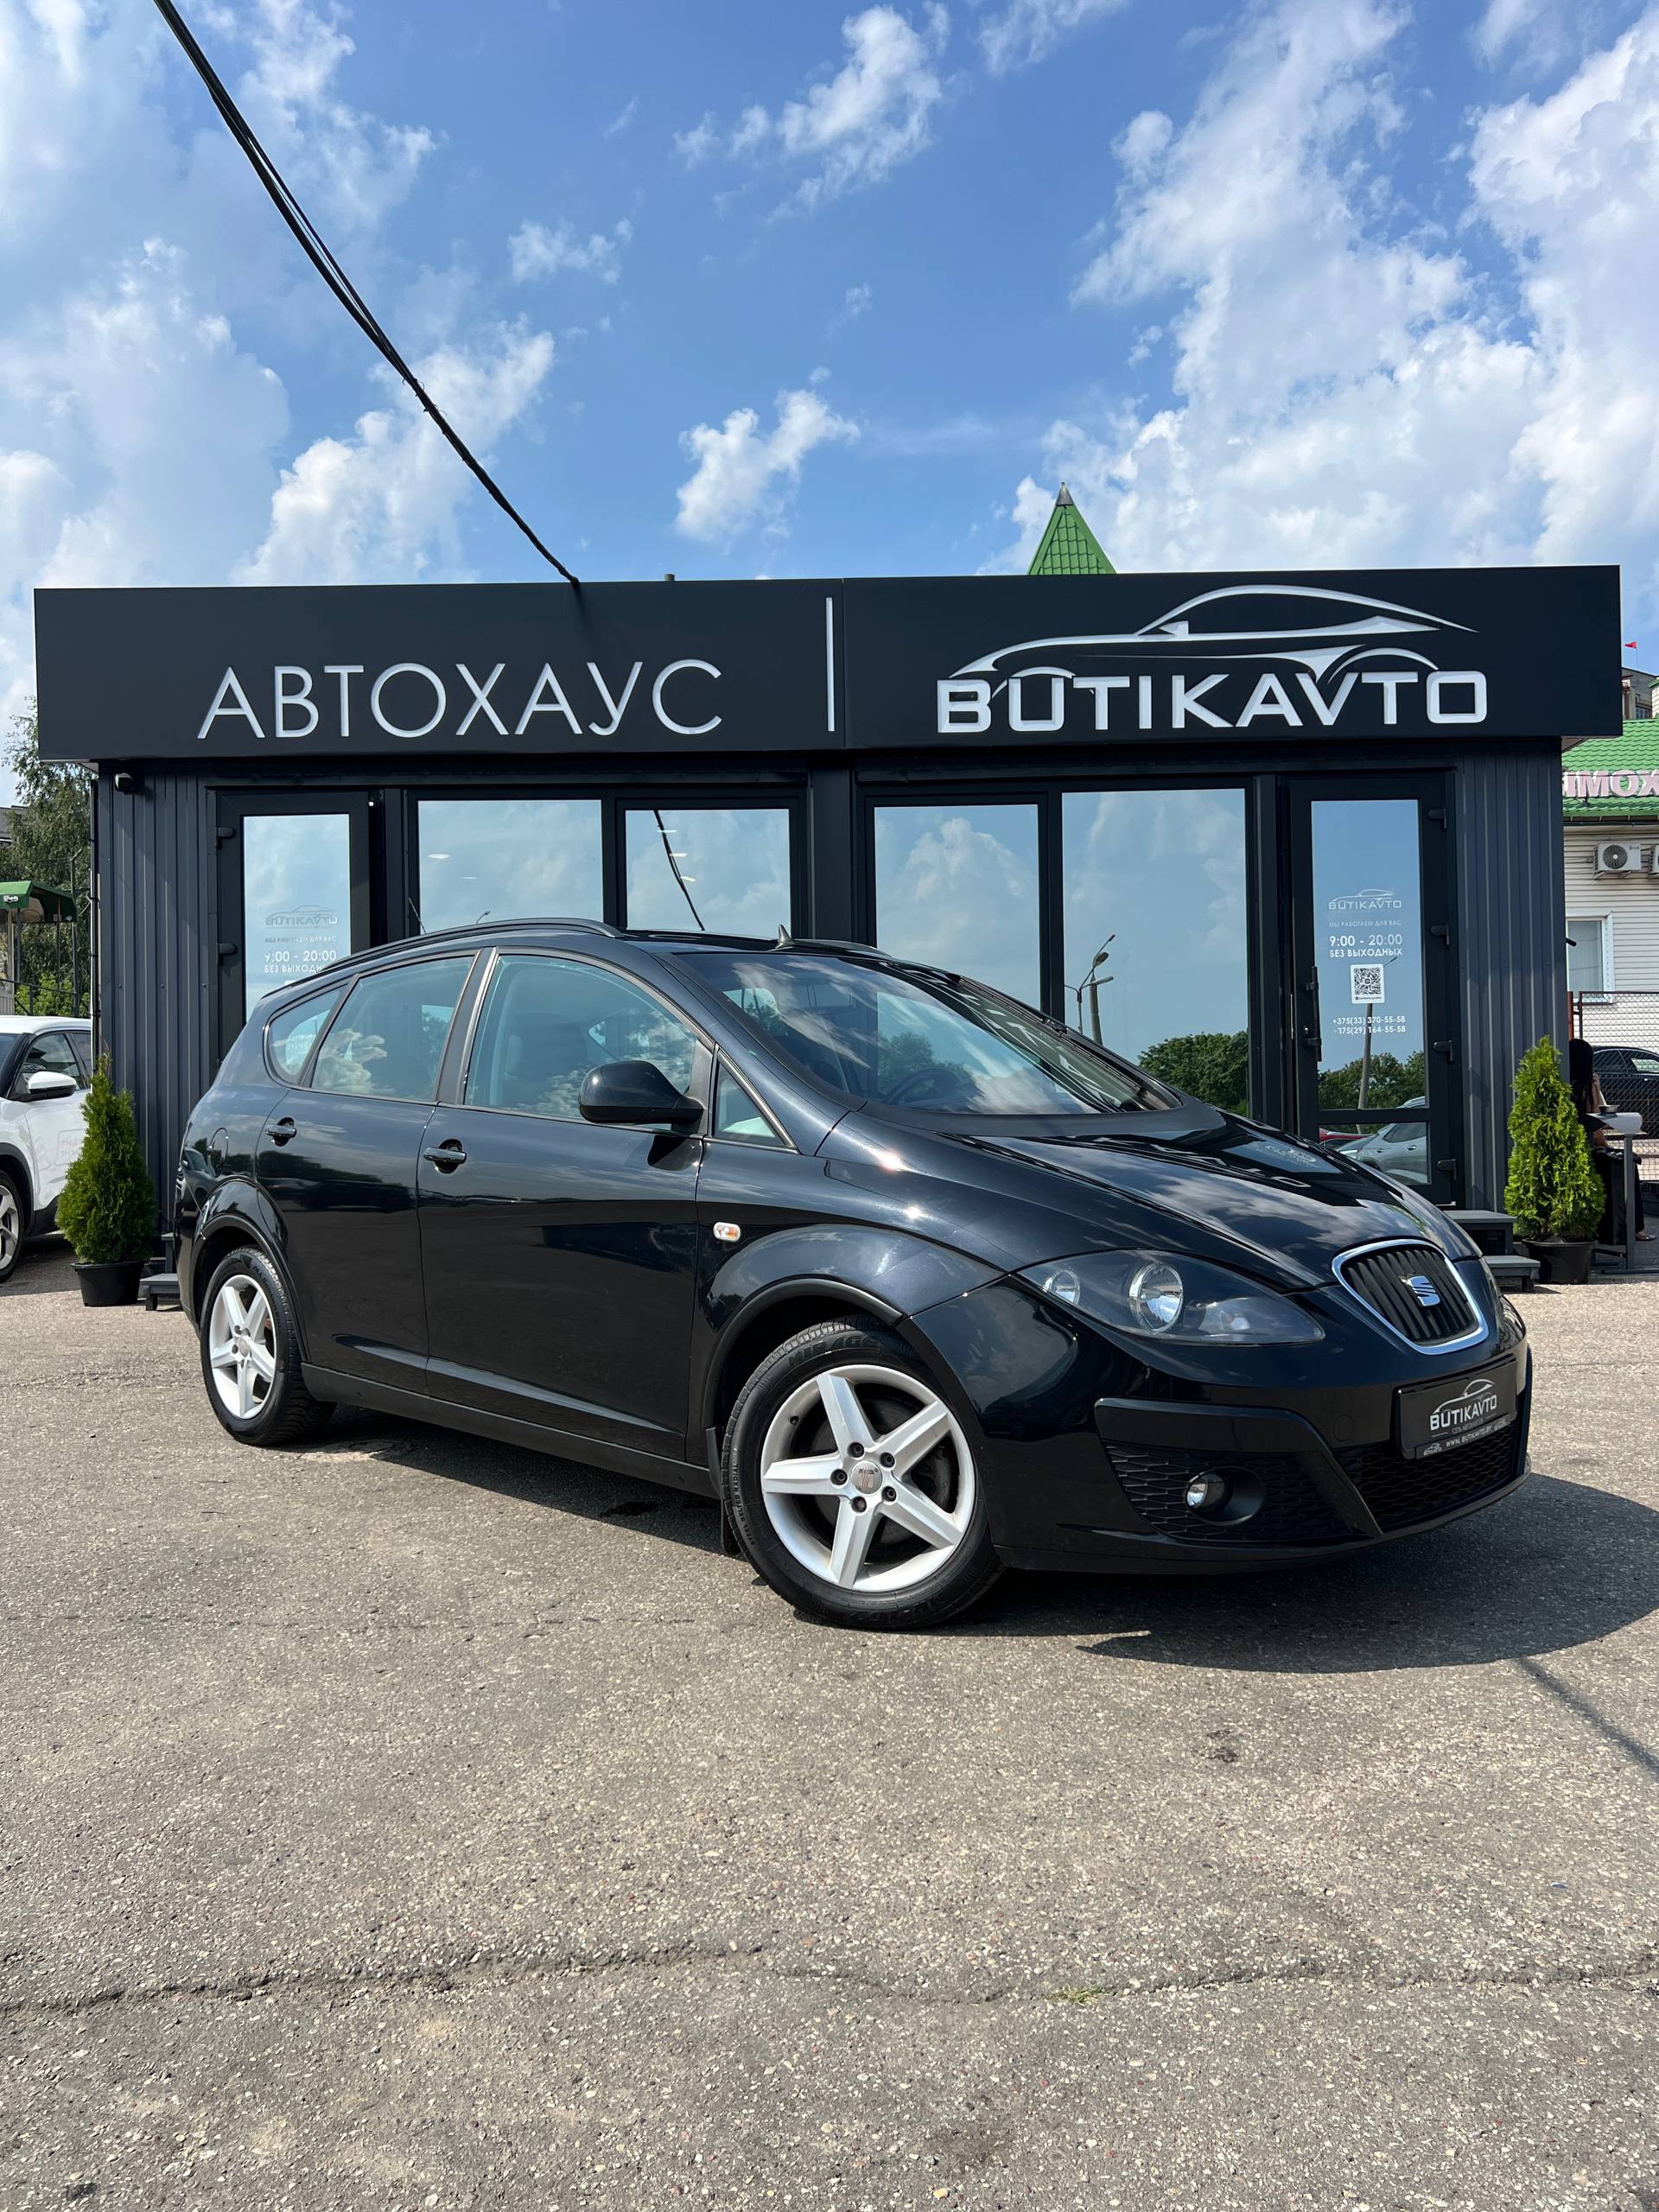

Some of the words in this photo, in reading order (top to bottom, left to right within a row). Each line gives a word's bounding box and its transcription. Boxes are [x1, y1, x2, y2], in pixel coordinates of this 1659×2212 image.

[197, 658, 722, 740] АВТОХАУС
[937, 670, 1489, 734] BUTIKAVTO
[1328, 899, 1402, 910] BUTIKAVTO
[1329, 935, 1356, 947] 9:00
[1368, 933, 1402, 946] 20:00
[302, 950, 337, 962] 20:00
[1329, 949, 1344, 958] БЕЗ
[1347, 947, 1403, 957] ВЫХОДНЫХ
[264, 964, 279, 974] БЕЗ
[1367, 1015, 1406, 1024] 370-55-58
[788, 1335, 881, 1366] MIRAGE
[1429, 1394, 1497, 1431] BUTIKAVTO
